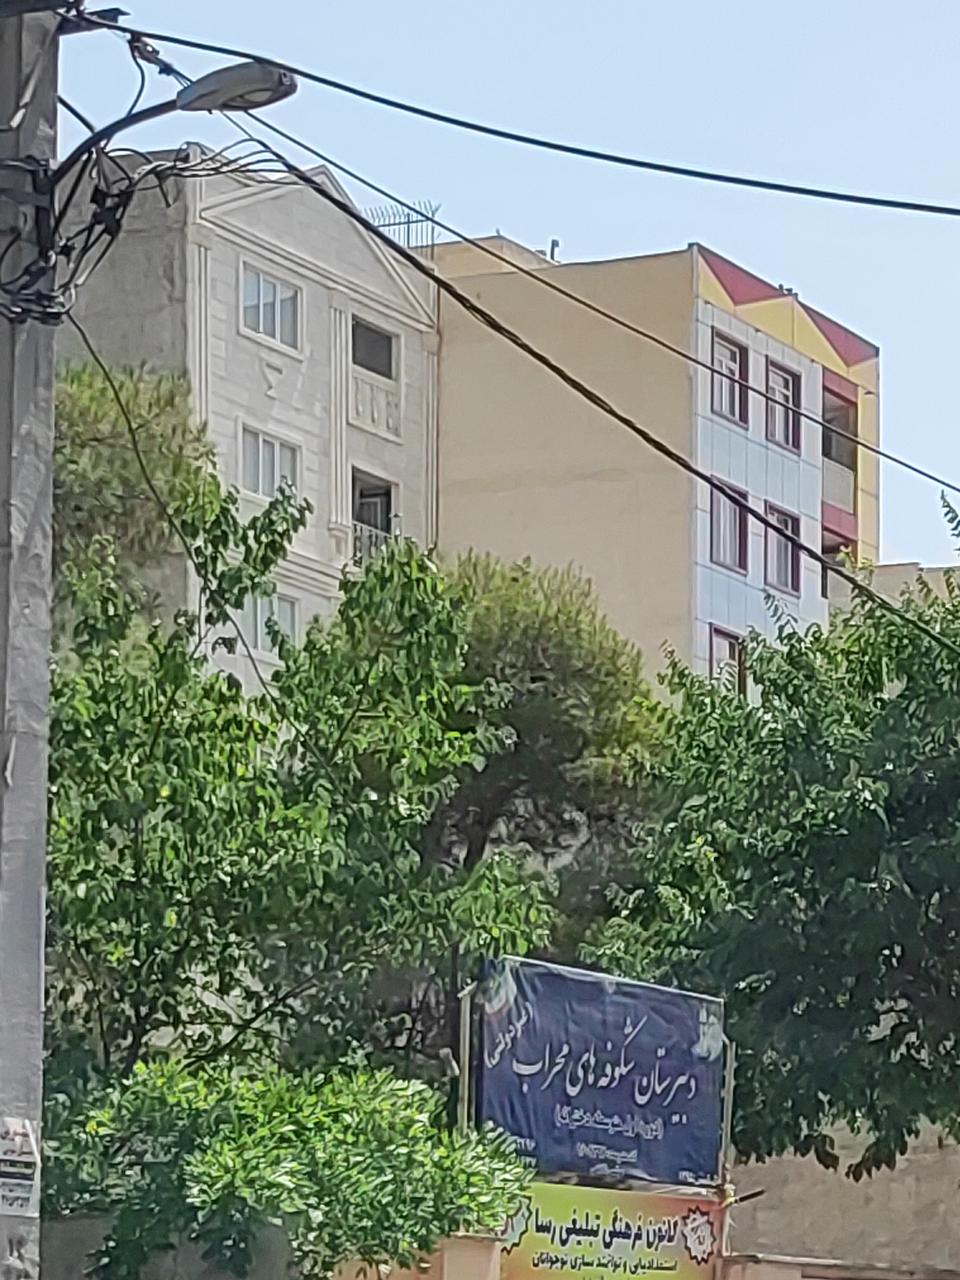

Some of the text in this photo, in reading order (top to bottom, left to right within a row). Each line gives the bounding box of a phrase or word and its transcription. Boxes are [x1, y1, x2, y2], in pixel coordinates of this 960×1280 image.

[512, 1015, 696, 1124] دبیرستان شکوفه های محراب
[534, 1207, 557, 1245] رسا
[559, 1209, 601, 1248] تبلیغی
[602, 1210, 643, 1250] فرهنگی
[646, 1217, 678, 1251] کانون
